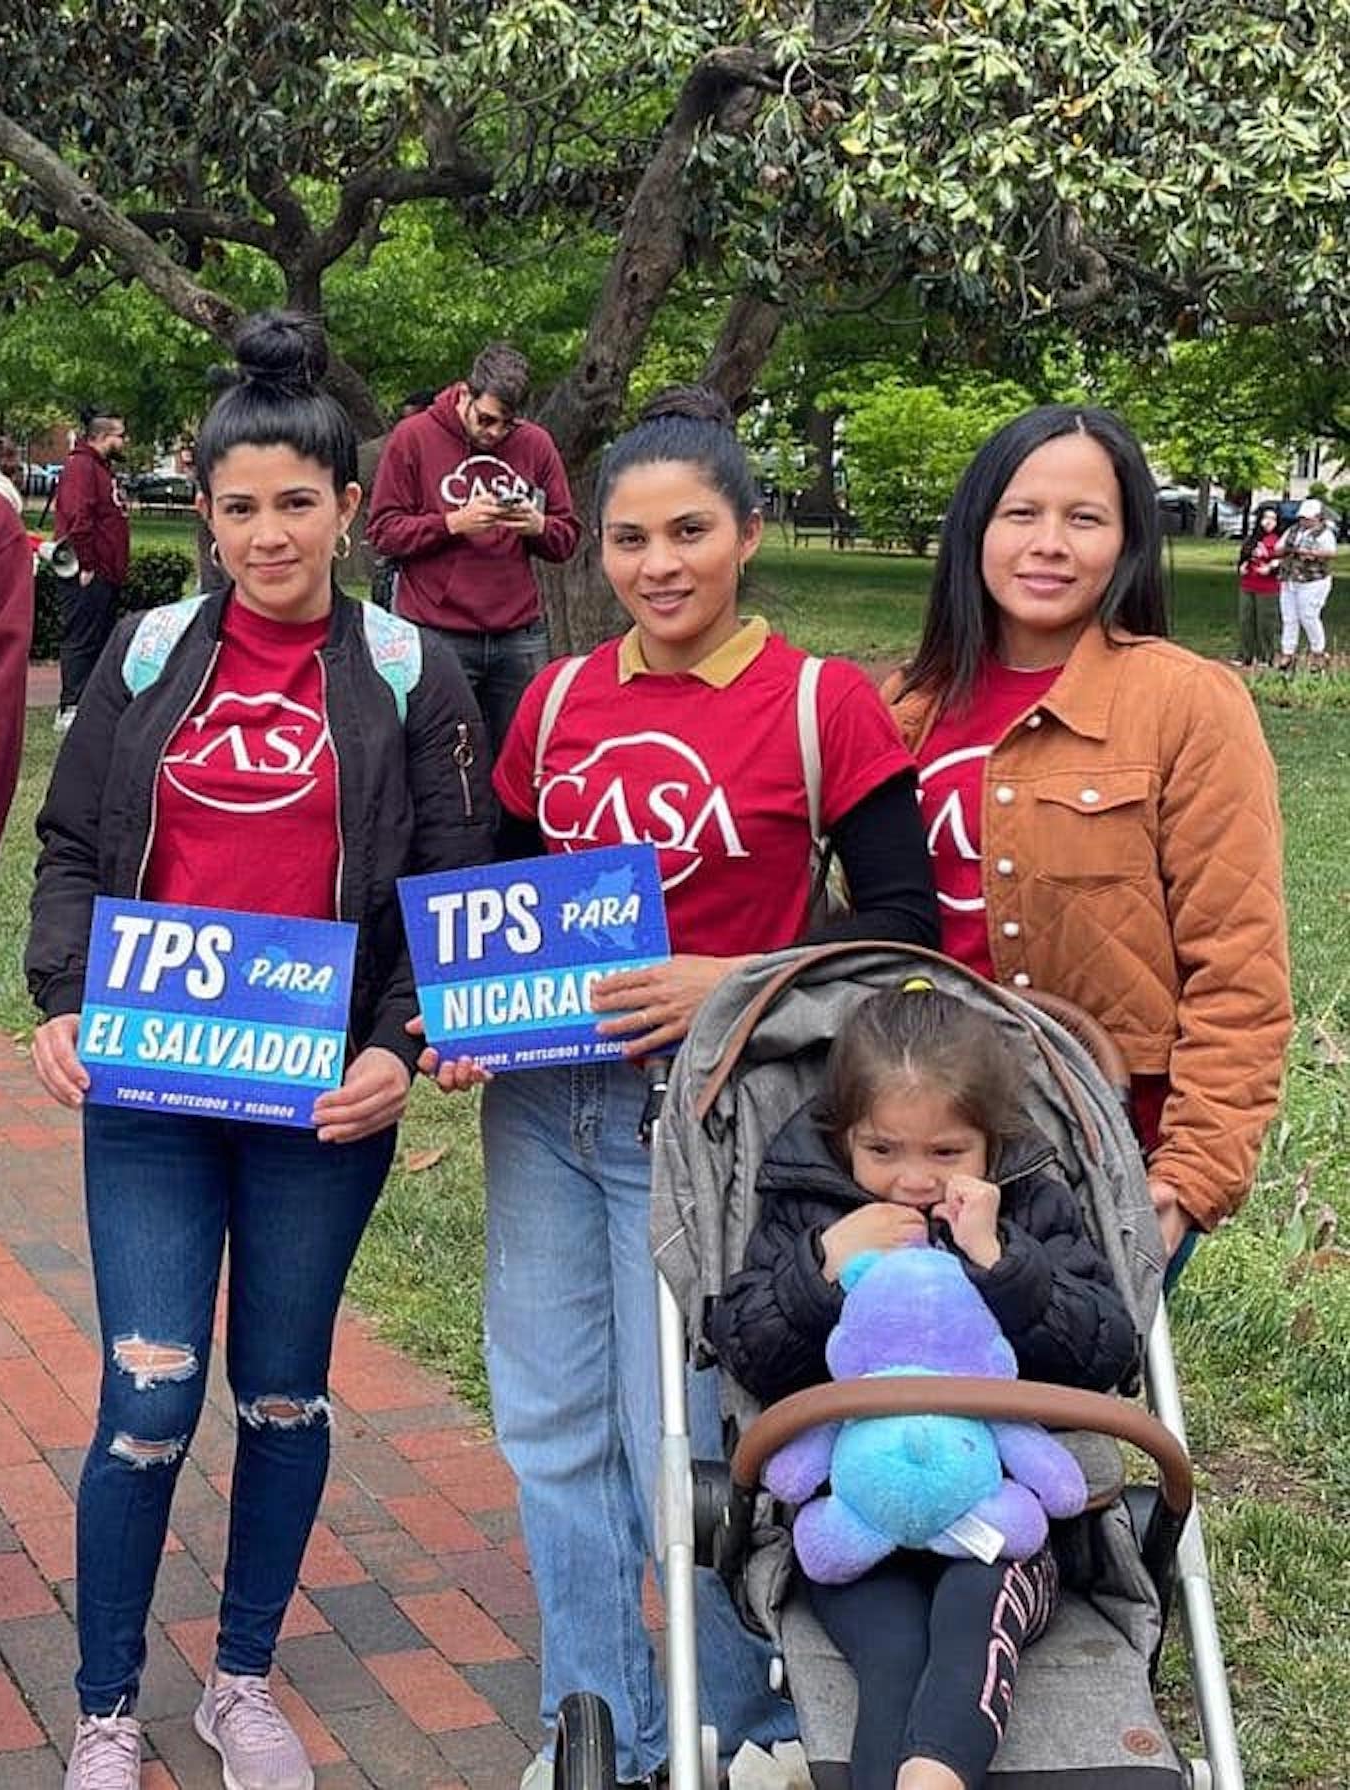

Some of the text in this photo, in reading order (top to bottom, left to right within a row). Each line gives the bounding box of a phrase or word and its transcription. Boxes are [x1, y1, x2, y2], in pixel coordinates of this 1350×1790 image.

[538, 775, 750, 857] CASA
[107, 915, 334, 1000] TPS PARA
[427, 882, 642, 965] TPS PARA
[84, 1013, 338, 1080] EL SALVADOR
